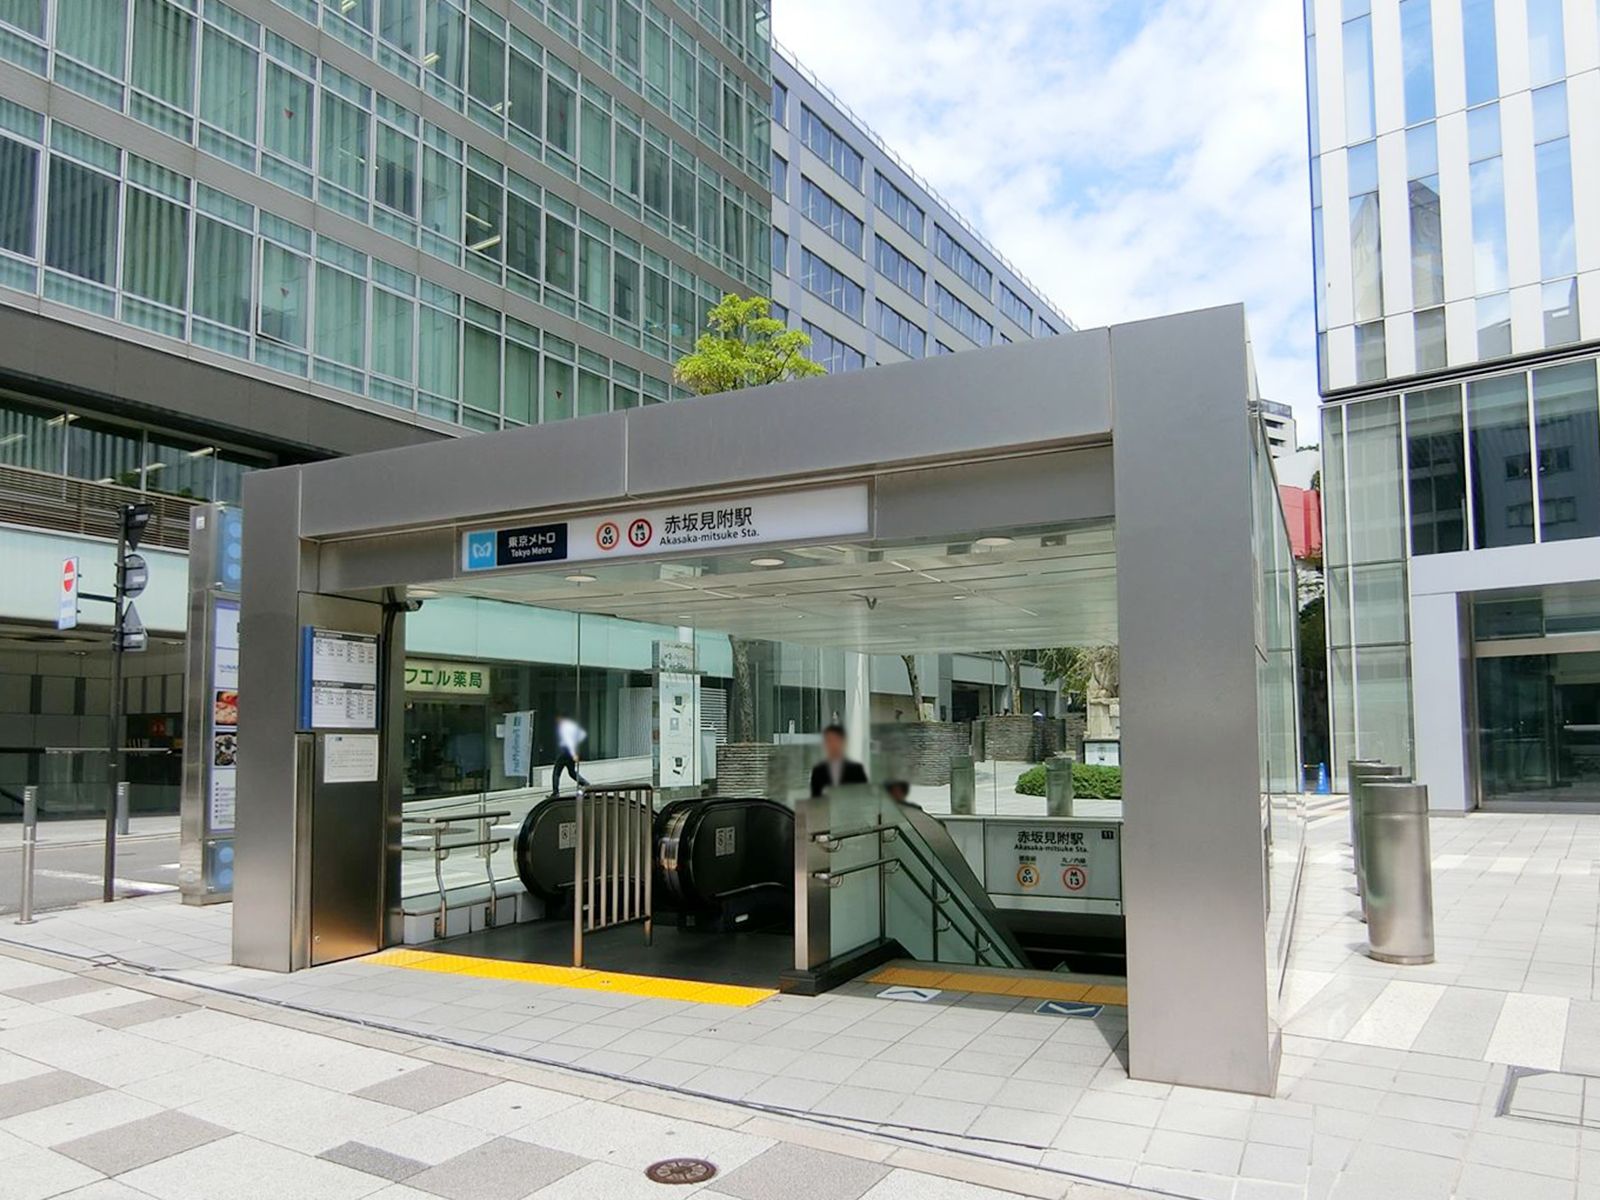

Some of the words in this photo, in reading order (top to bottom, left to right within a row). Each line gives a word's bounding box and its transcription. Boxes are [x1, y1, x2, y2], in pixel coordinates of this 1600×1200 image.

[664, 506, 753, 535] 赤坂見附駅
[603, 526, 612, 535] G
[636, 523, 645, 532] M
[508, 532, 556, 548] 東京メトロ
[602, 535, 614, 545] 05
[634, 532, 647, 542] 13
[659, 530, 739, 546] Akasaka-mitsuke
[741, 527, 760, 538] Sta.
[511, 548, 531, 558] Tokyo
[531, 546, 553, 556] Metro
[1017, 830, 1084, 846] 赤坂見附駅
[1013, 844, 1074, 853] Akasaka-mitsuke
[1075, 845, 1090, 853] Sta.
[1024, 868, 1032, 876] G
[1022, 875, 1034, 883] 05
[1069, 877, 1080, 886] 13
